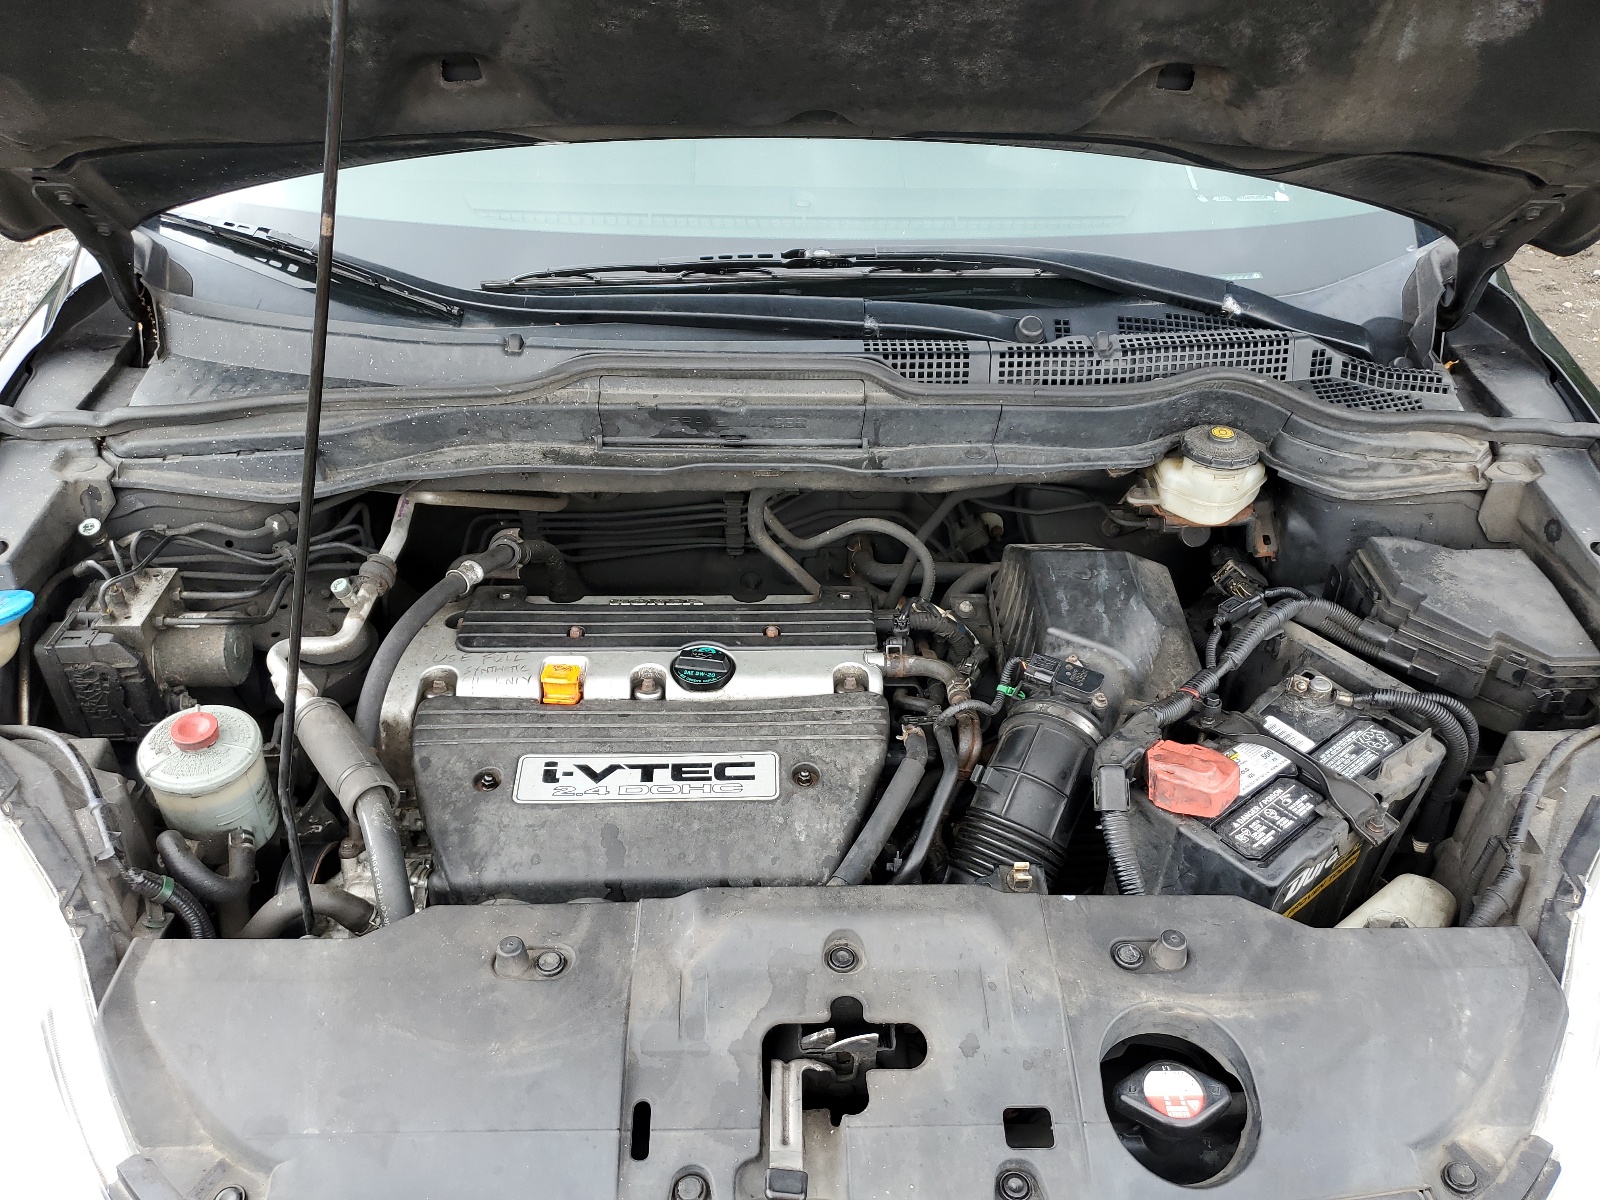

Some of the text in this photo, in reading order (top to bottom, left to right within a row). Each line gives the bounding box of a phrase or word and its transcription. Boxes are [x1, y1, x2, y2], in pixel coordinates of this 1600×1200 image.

[541, 760, 756, 784] i-VTEC
[552, 783, 744, 796] 2.4 DOHC
